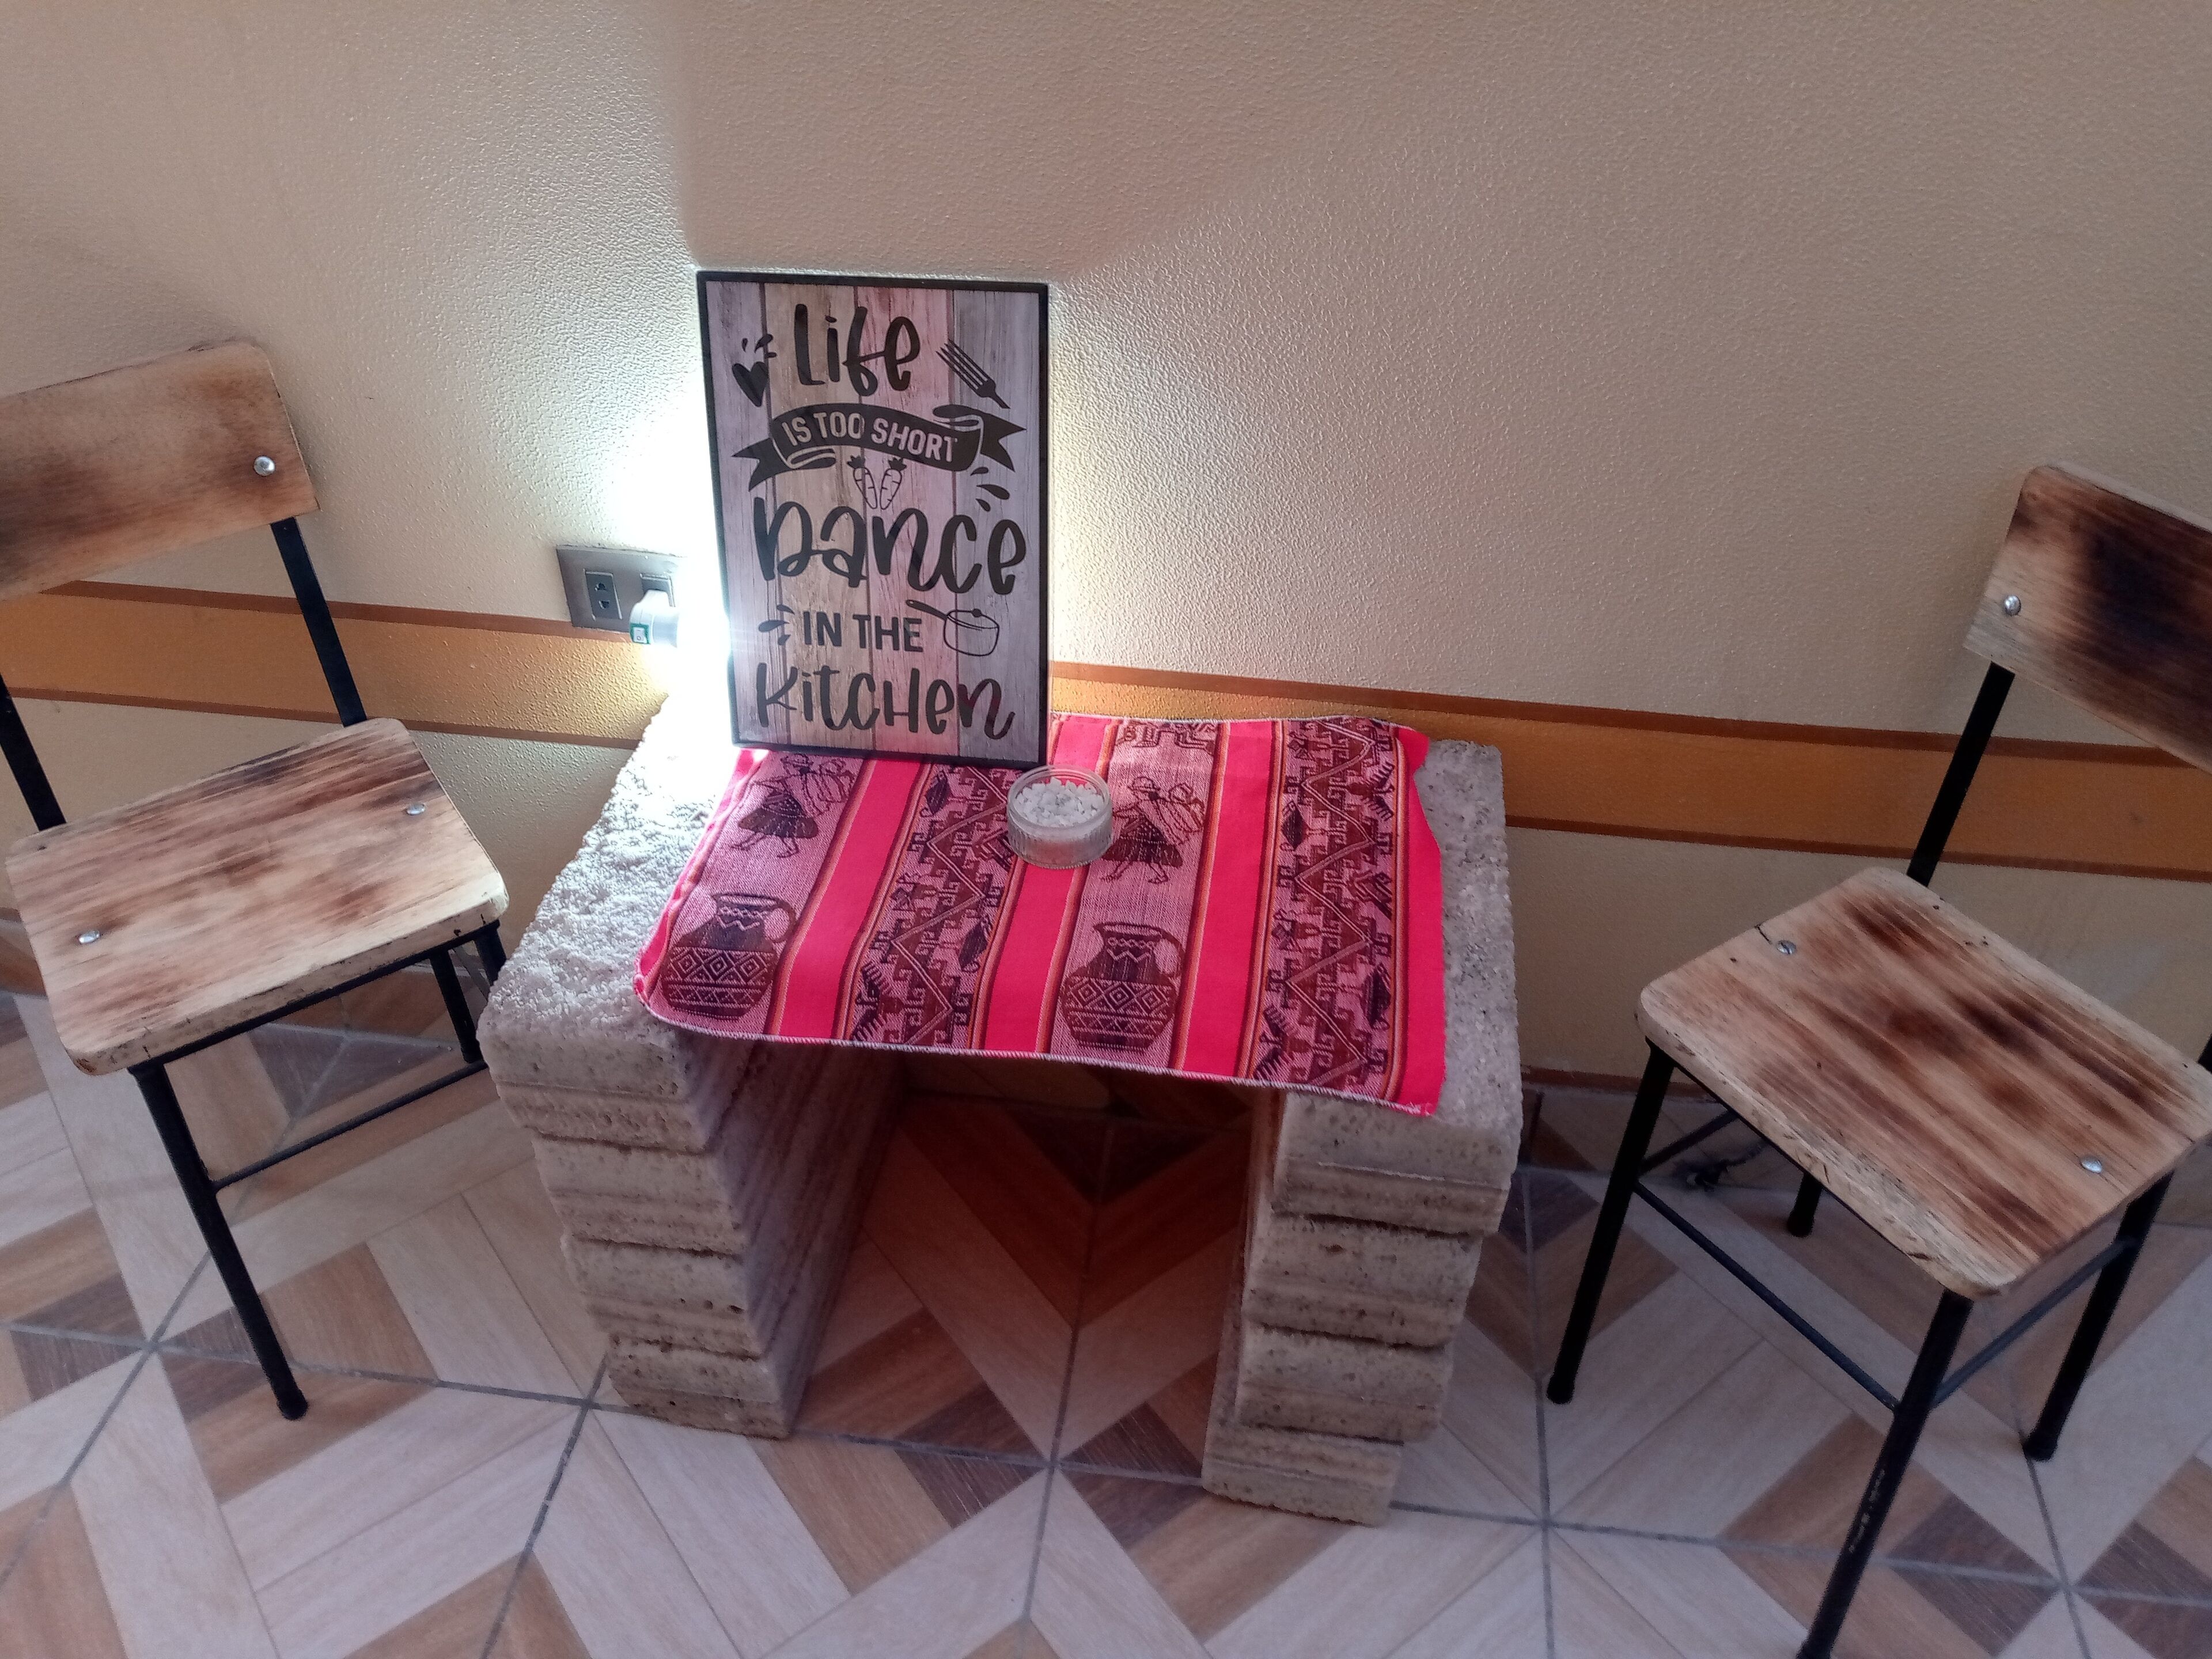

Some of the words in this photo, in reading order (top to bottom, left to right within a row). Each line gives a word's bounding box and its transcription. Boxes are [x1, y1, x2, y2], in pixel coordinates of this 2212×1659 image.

[794, 303, 921, 396] Life
[782, 413, 812, 445] IS
[815, 411, 864, 440] TOO
[872, 416, 958, 463] SHORT
[753, 497, 1027, 596] Dance
[804, 611, 842, 647] IN
[853, 613, 923, 652] THE
